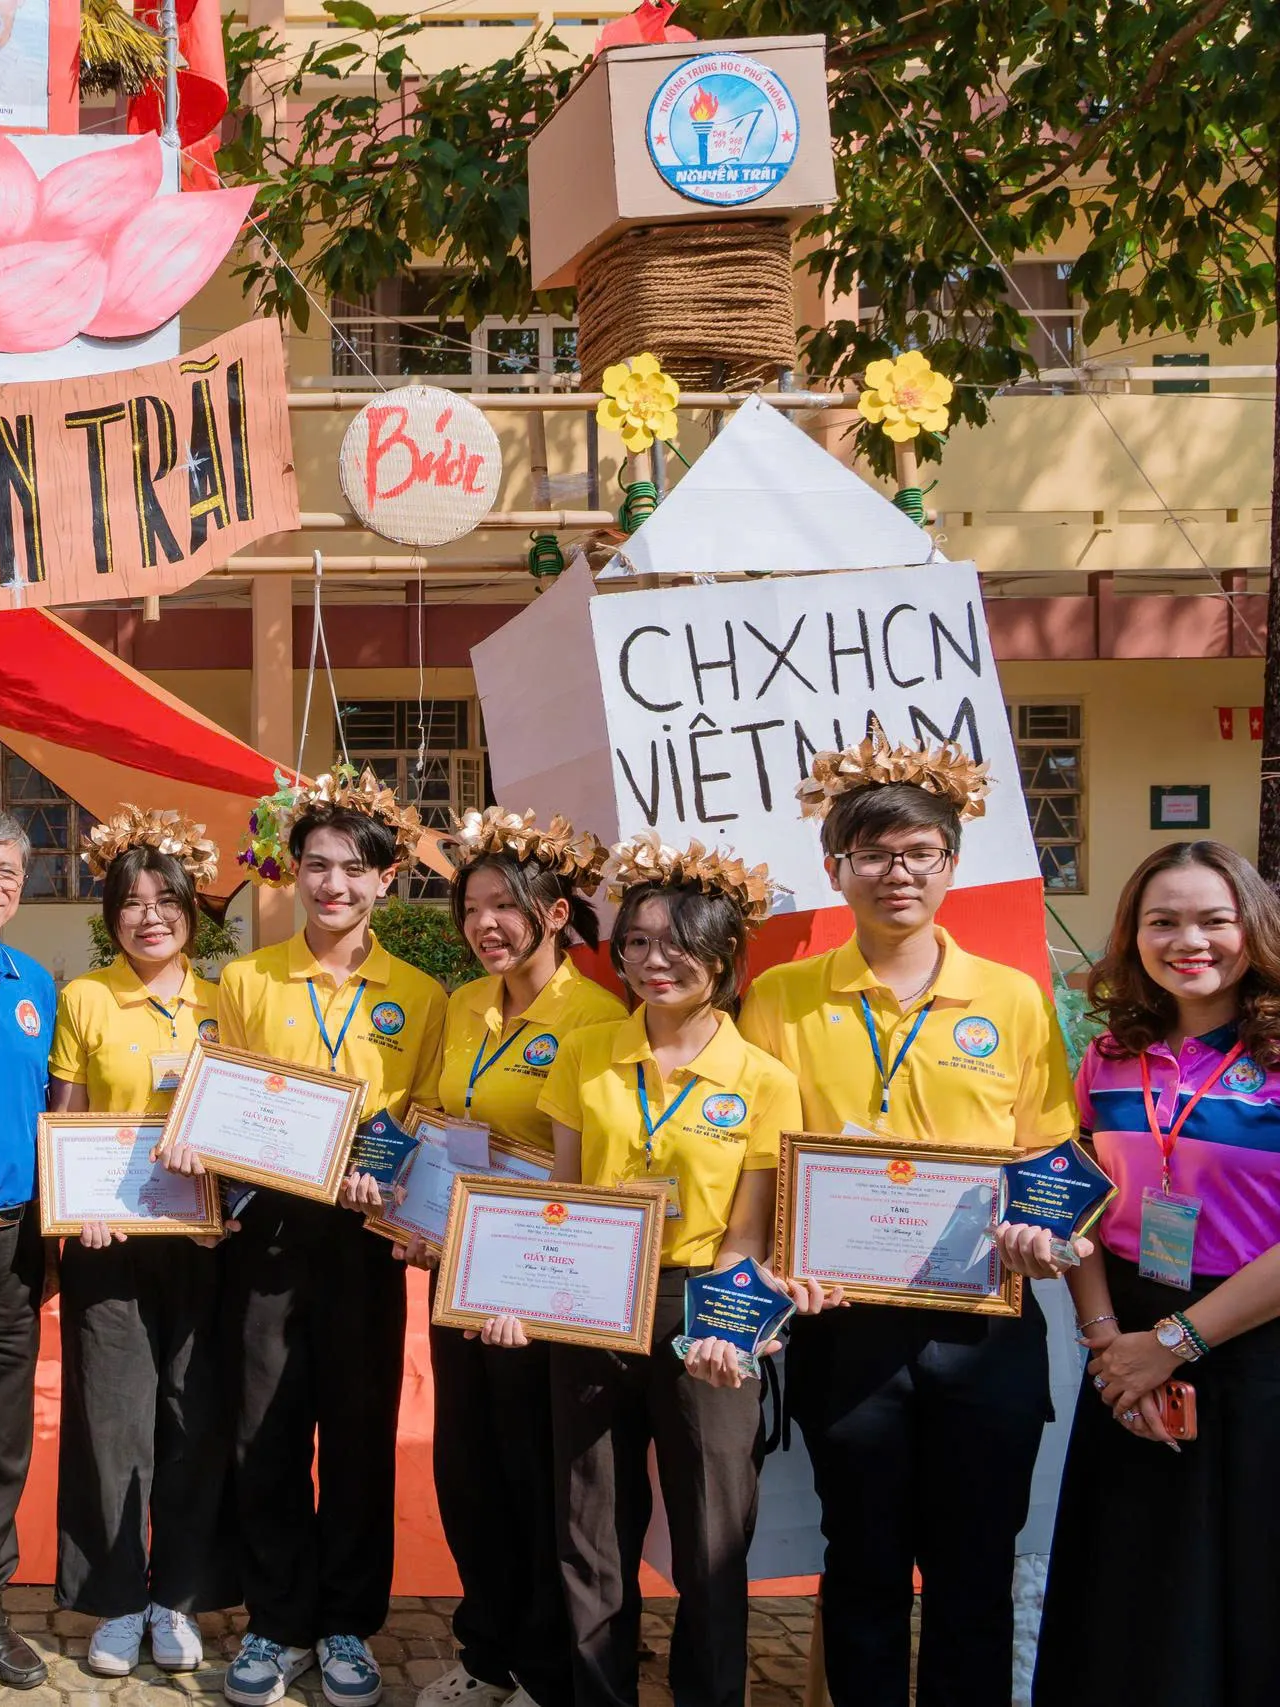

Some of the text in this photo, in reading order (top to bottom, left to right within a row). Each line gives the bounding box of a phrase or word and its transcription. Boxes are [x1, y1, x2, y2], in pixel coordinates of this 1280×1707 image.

[686, 62, 718, 79] TRUNG
[720, 62, 742, 73] HỌC
[743, 66, 767, 82] PHỔ
[762, 79, 787, 112] THÔNG
[676, 163, 777, 183] NGUYỄN TRÃI
[65, 353, 255, 573] TRÃI
[619, 600, 982, 713] CHXHCN
[870, 1212, 928, 1227] GIẤY KHEN
[523, 1251, 575, 1265] GIẤY KHEN
